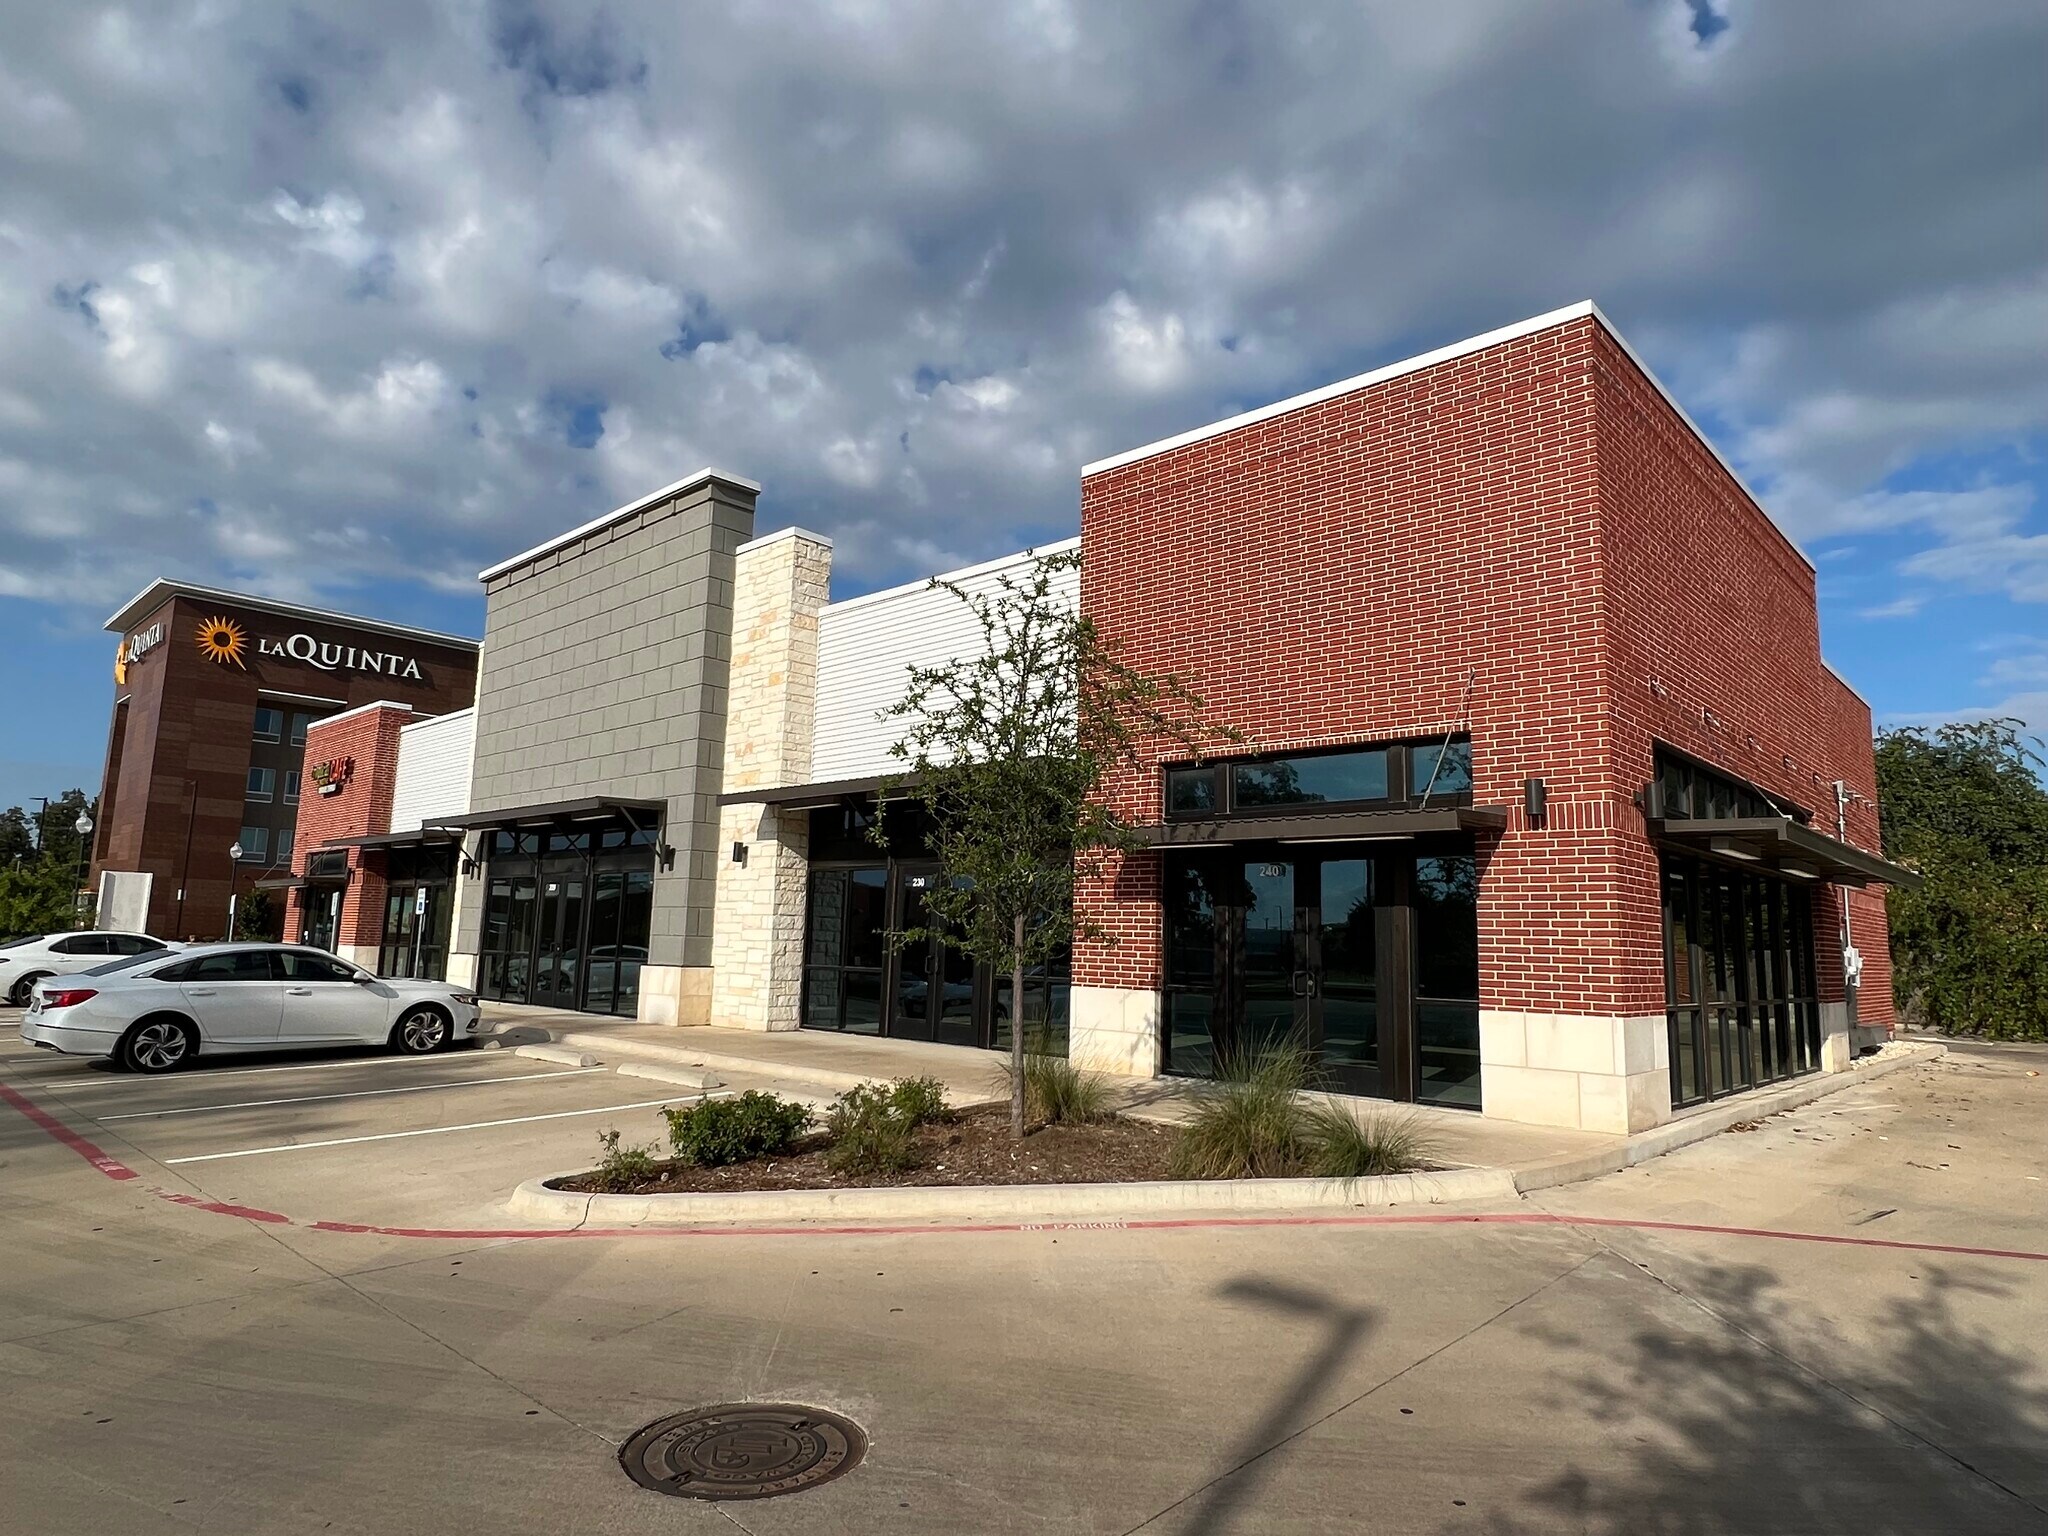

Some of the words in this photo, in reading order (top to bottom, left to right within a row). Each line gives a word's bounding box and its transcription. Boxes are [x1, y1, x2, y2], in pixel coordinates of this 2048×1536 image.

[1259, 864, 1279, 877] 240
[1020, 1223, 1043, 1231] NO
[1053, 1222, 1128, 1231] PARKING
